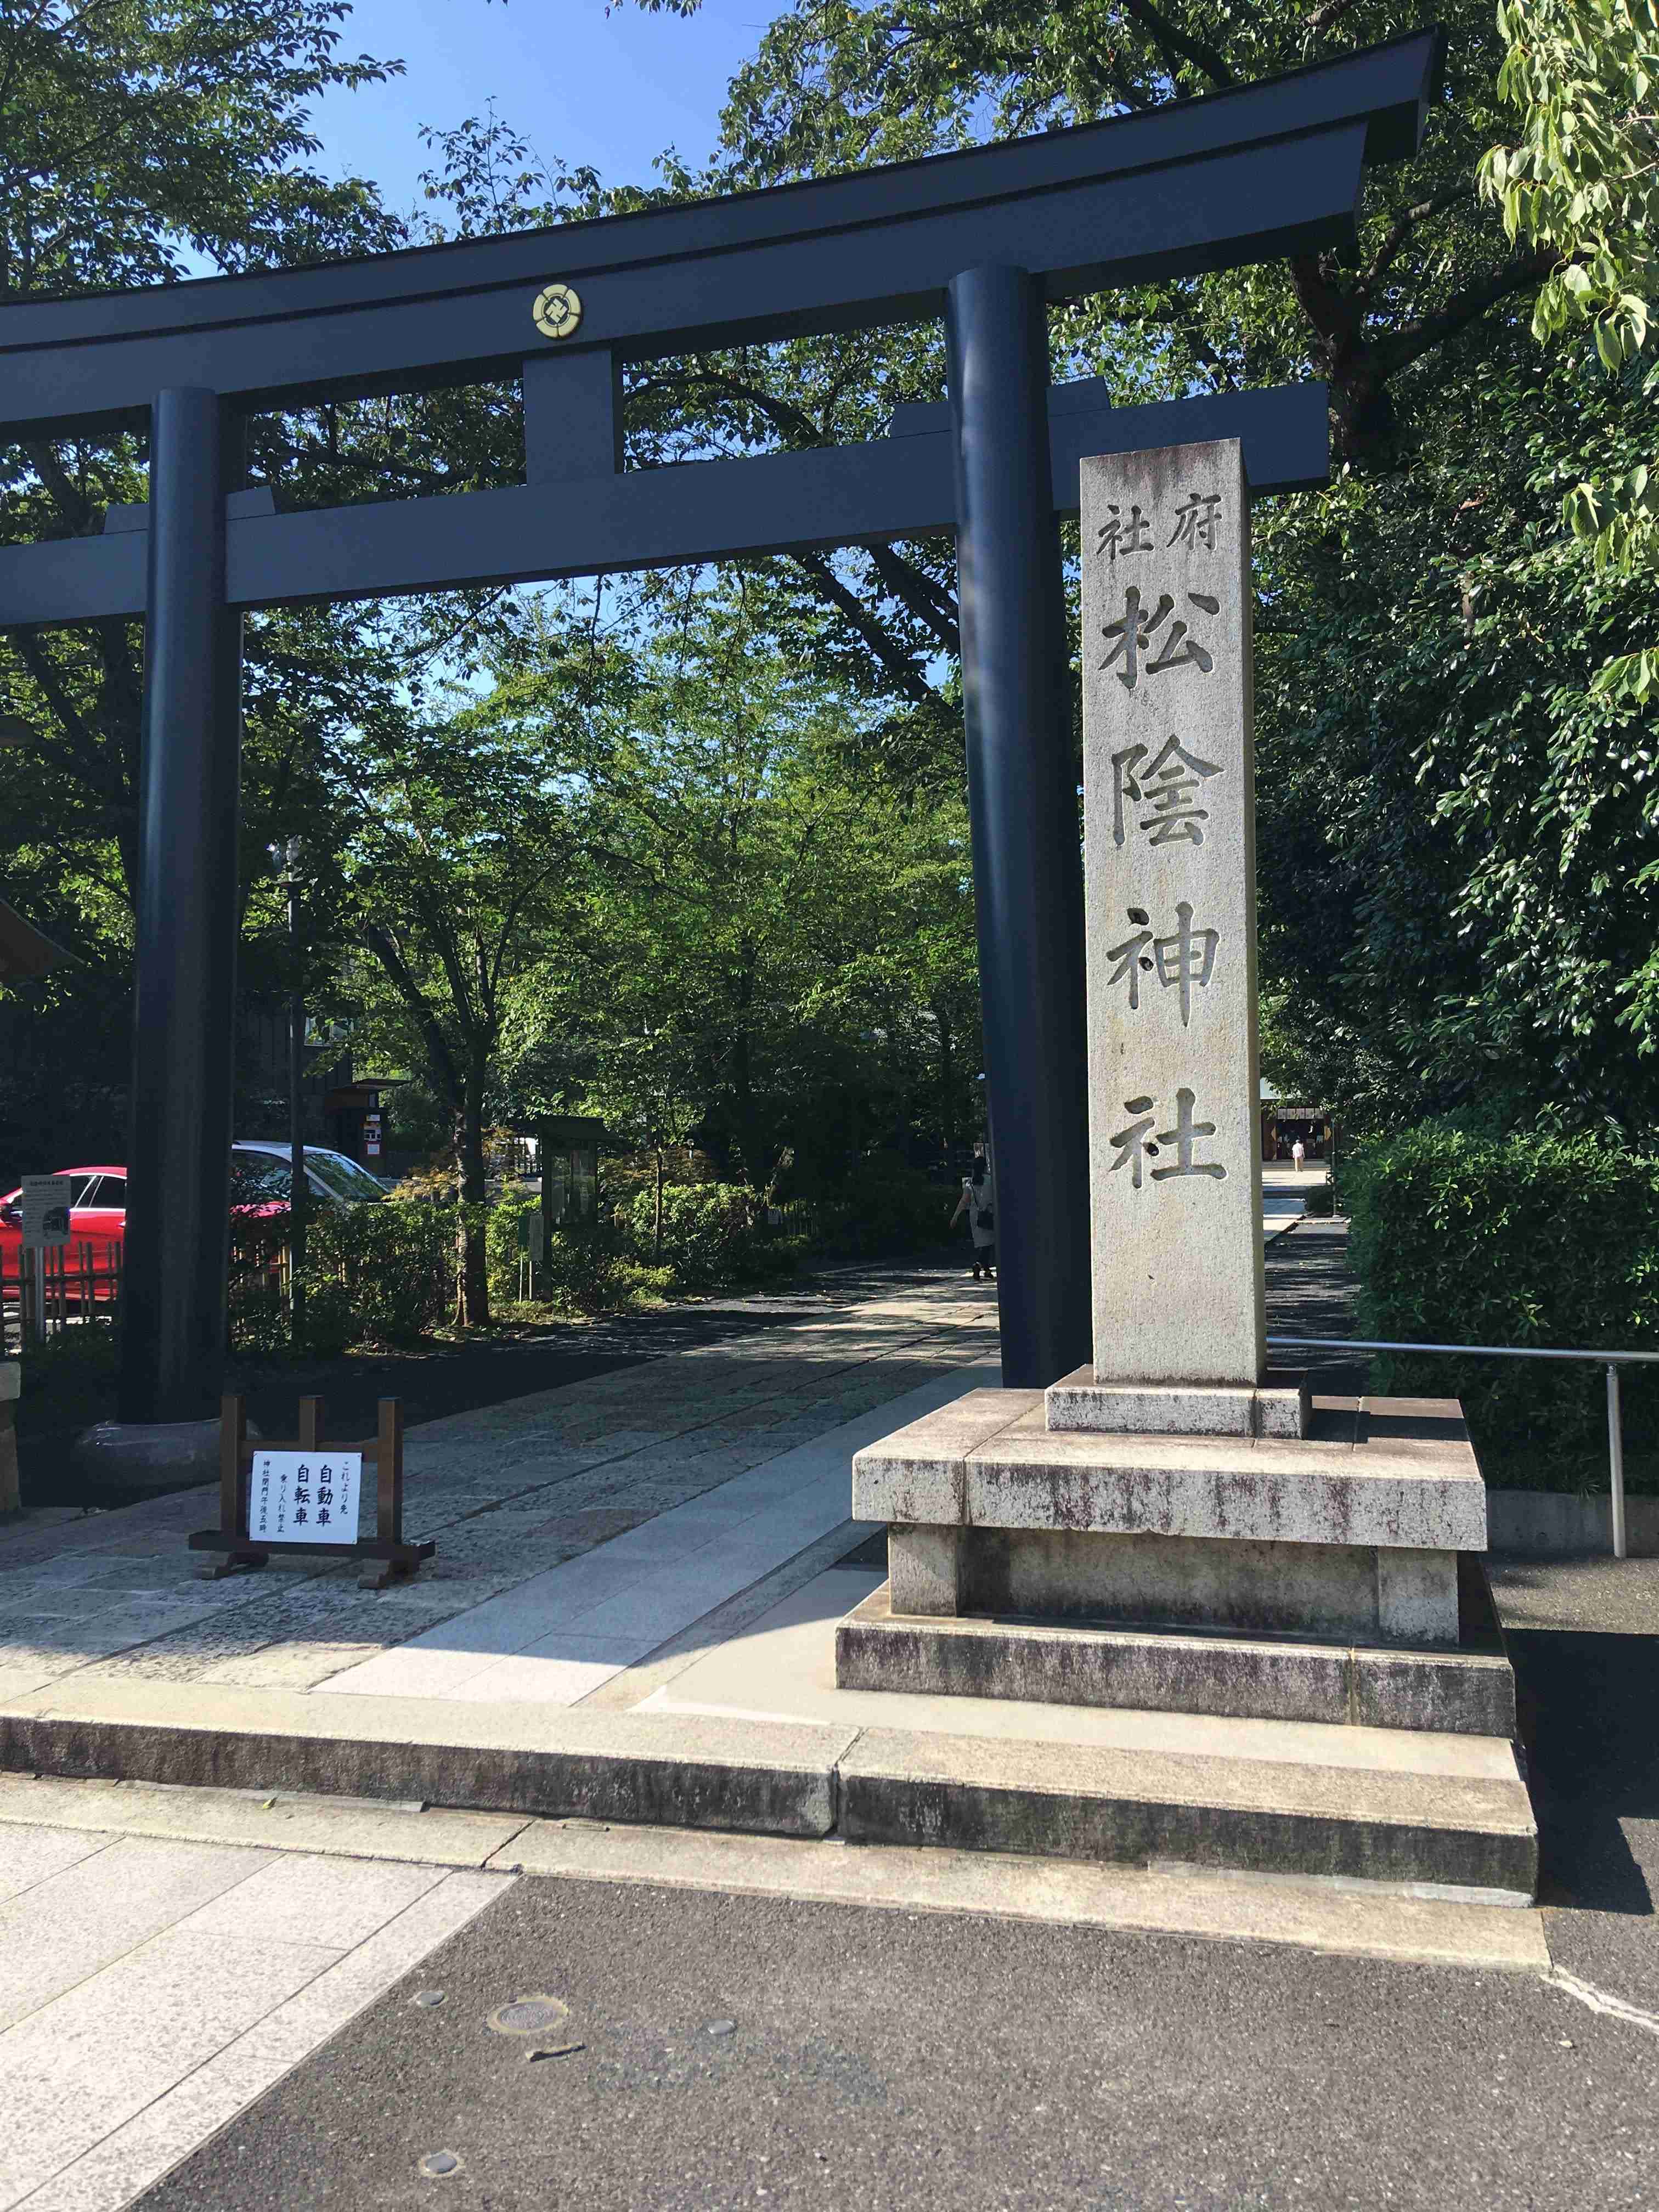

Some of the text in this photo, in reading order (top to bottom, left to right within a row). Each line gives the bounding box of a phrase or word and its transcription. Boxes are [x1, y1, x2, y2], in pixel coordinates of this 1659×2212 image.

[1097, 585, 1227, 1189] 松陰神社
[293, 1464, 311, 1526] 自転車
[316, 1464, 333, 1527] 自動車
[340, 1461, 350, 1515] これより先
